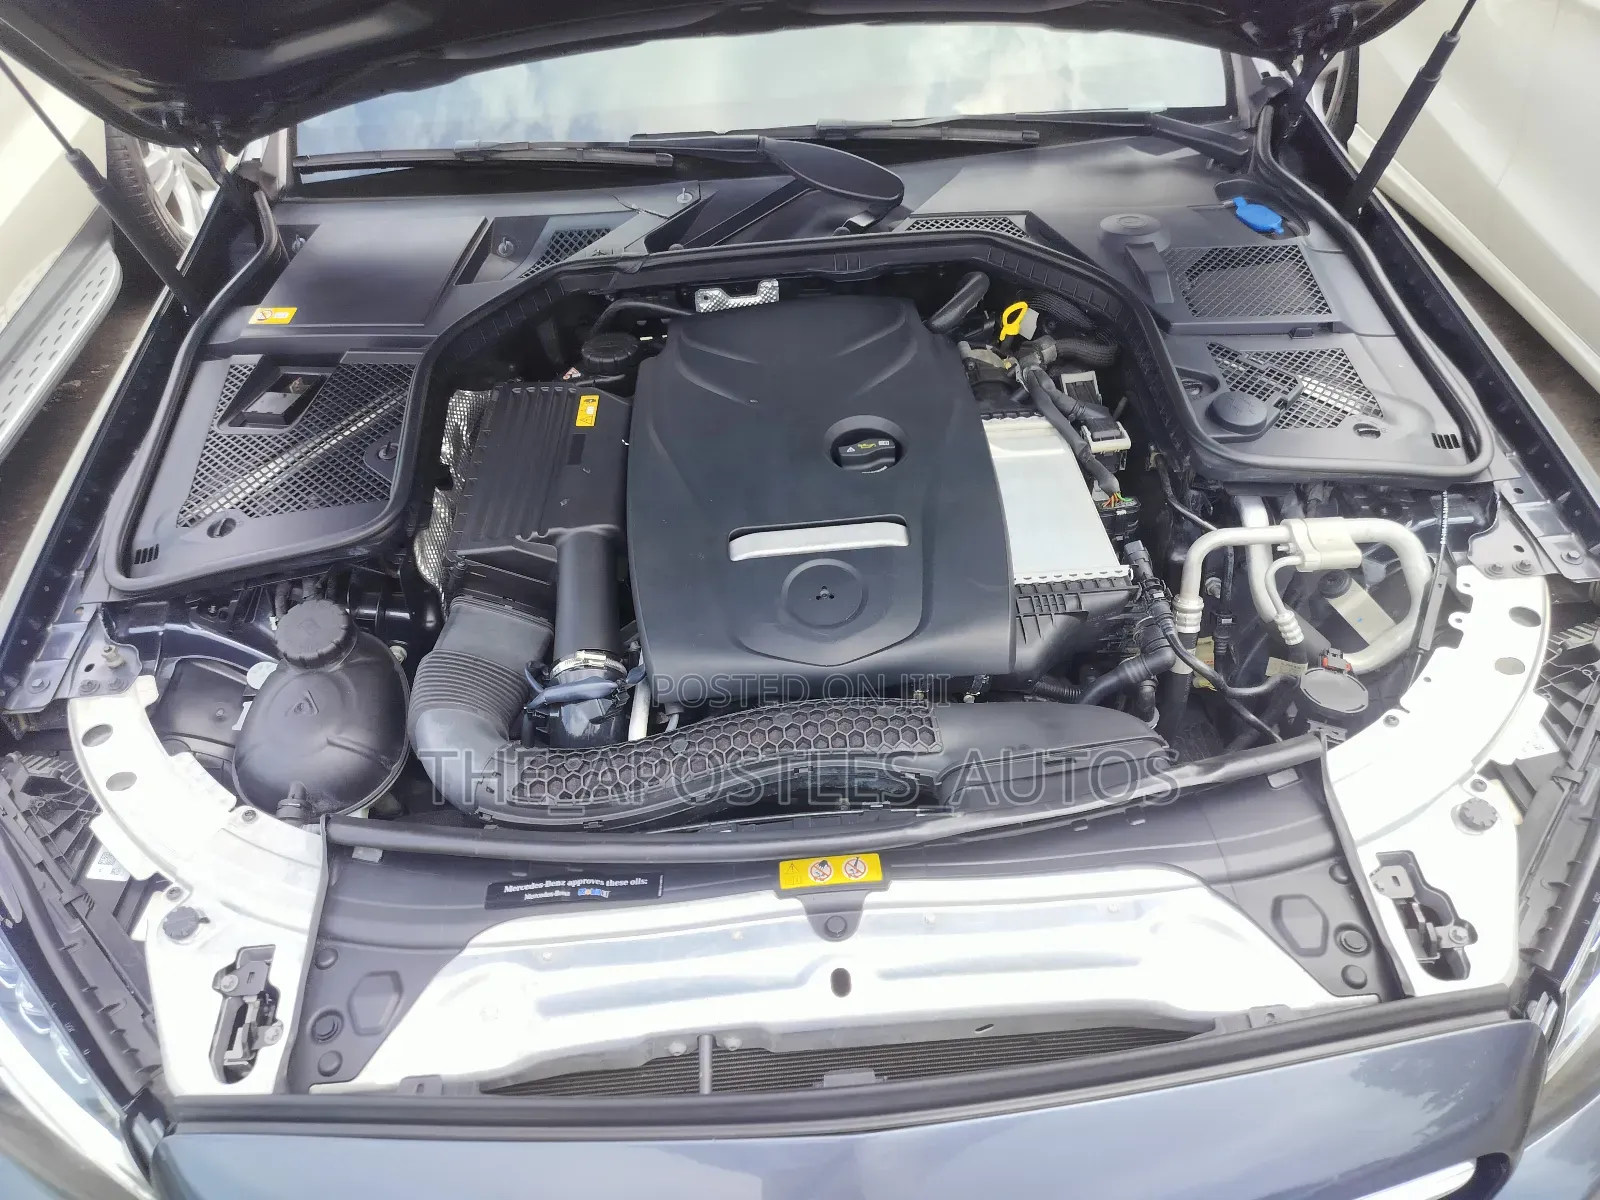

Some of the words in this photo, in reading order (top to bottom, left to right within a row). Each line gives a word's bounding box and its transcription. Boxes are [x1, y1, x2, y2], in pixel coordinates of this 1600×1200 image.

[503, 880, 566, 893] Mercedes-Benz
[567, 879, 604, 887] approves
[630, 878, 648, 886] oils:
